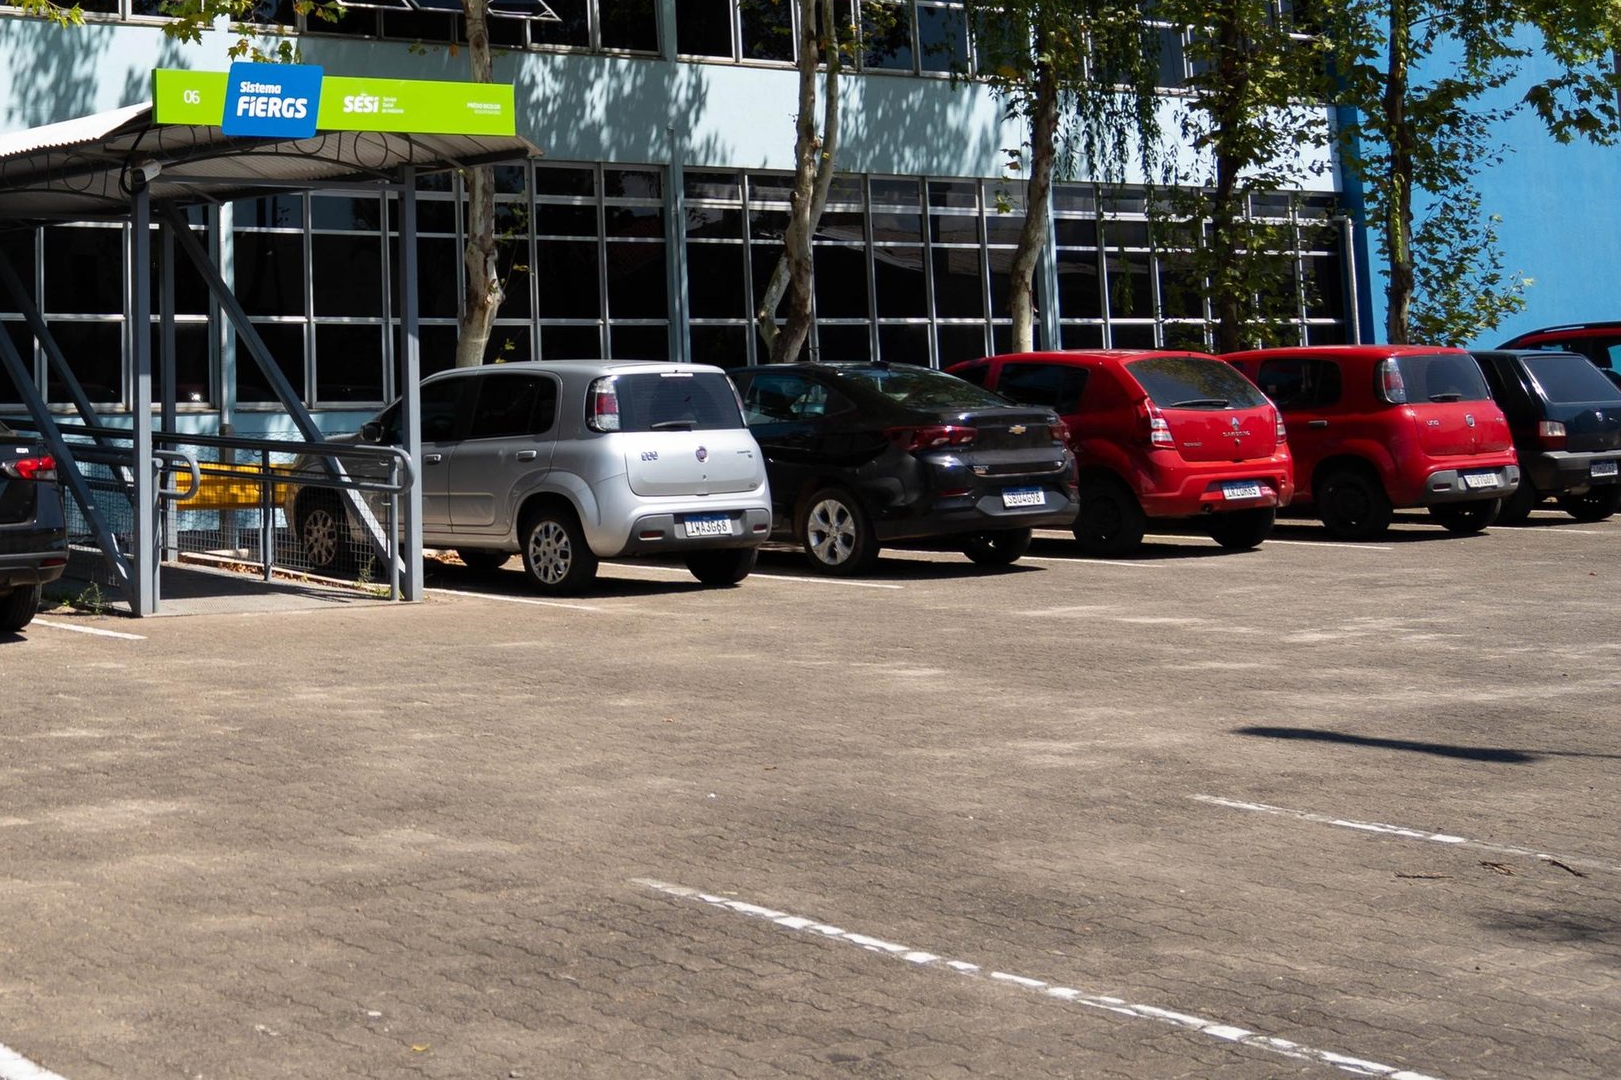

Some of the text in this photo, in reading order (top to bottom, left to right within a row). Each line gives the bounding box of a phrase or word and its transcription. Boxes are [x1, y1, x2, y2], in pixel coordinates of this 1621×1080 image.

[239, 81, 281, 95] Sistema
[183, 90, 200, 105] 06
[236, 96, 308, 119] FIERGS
